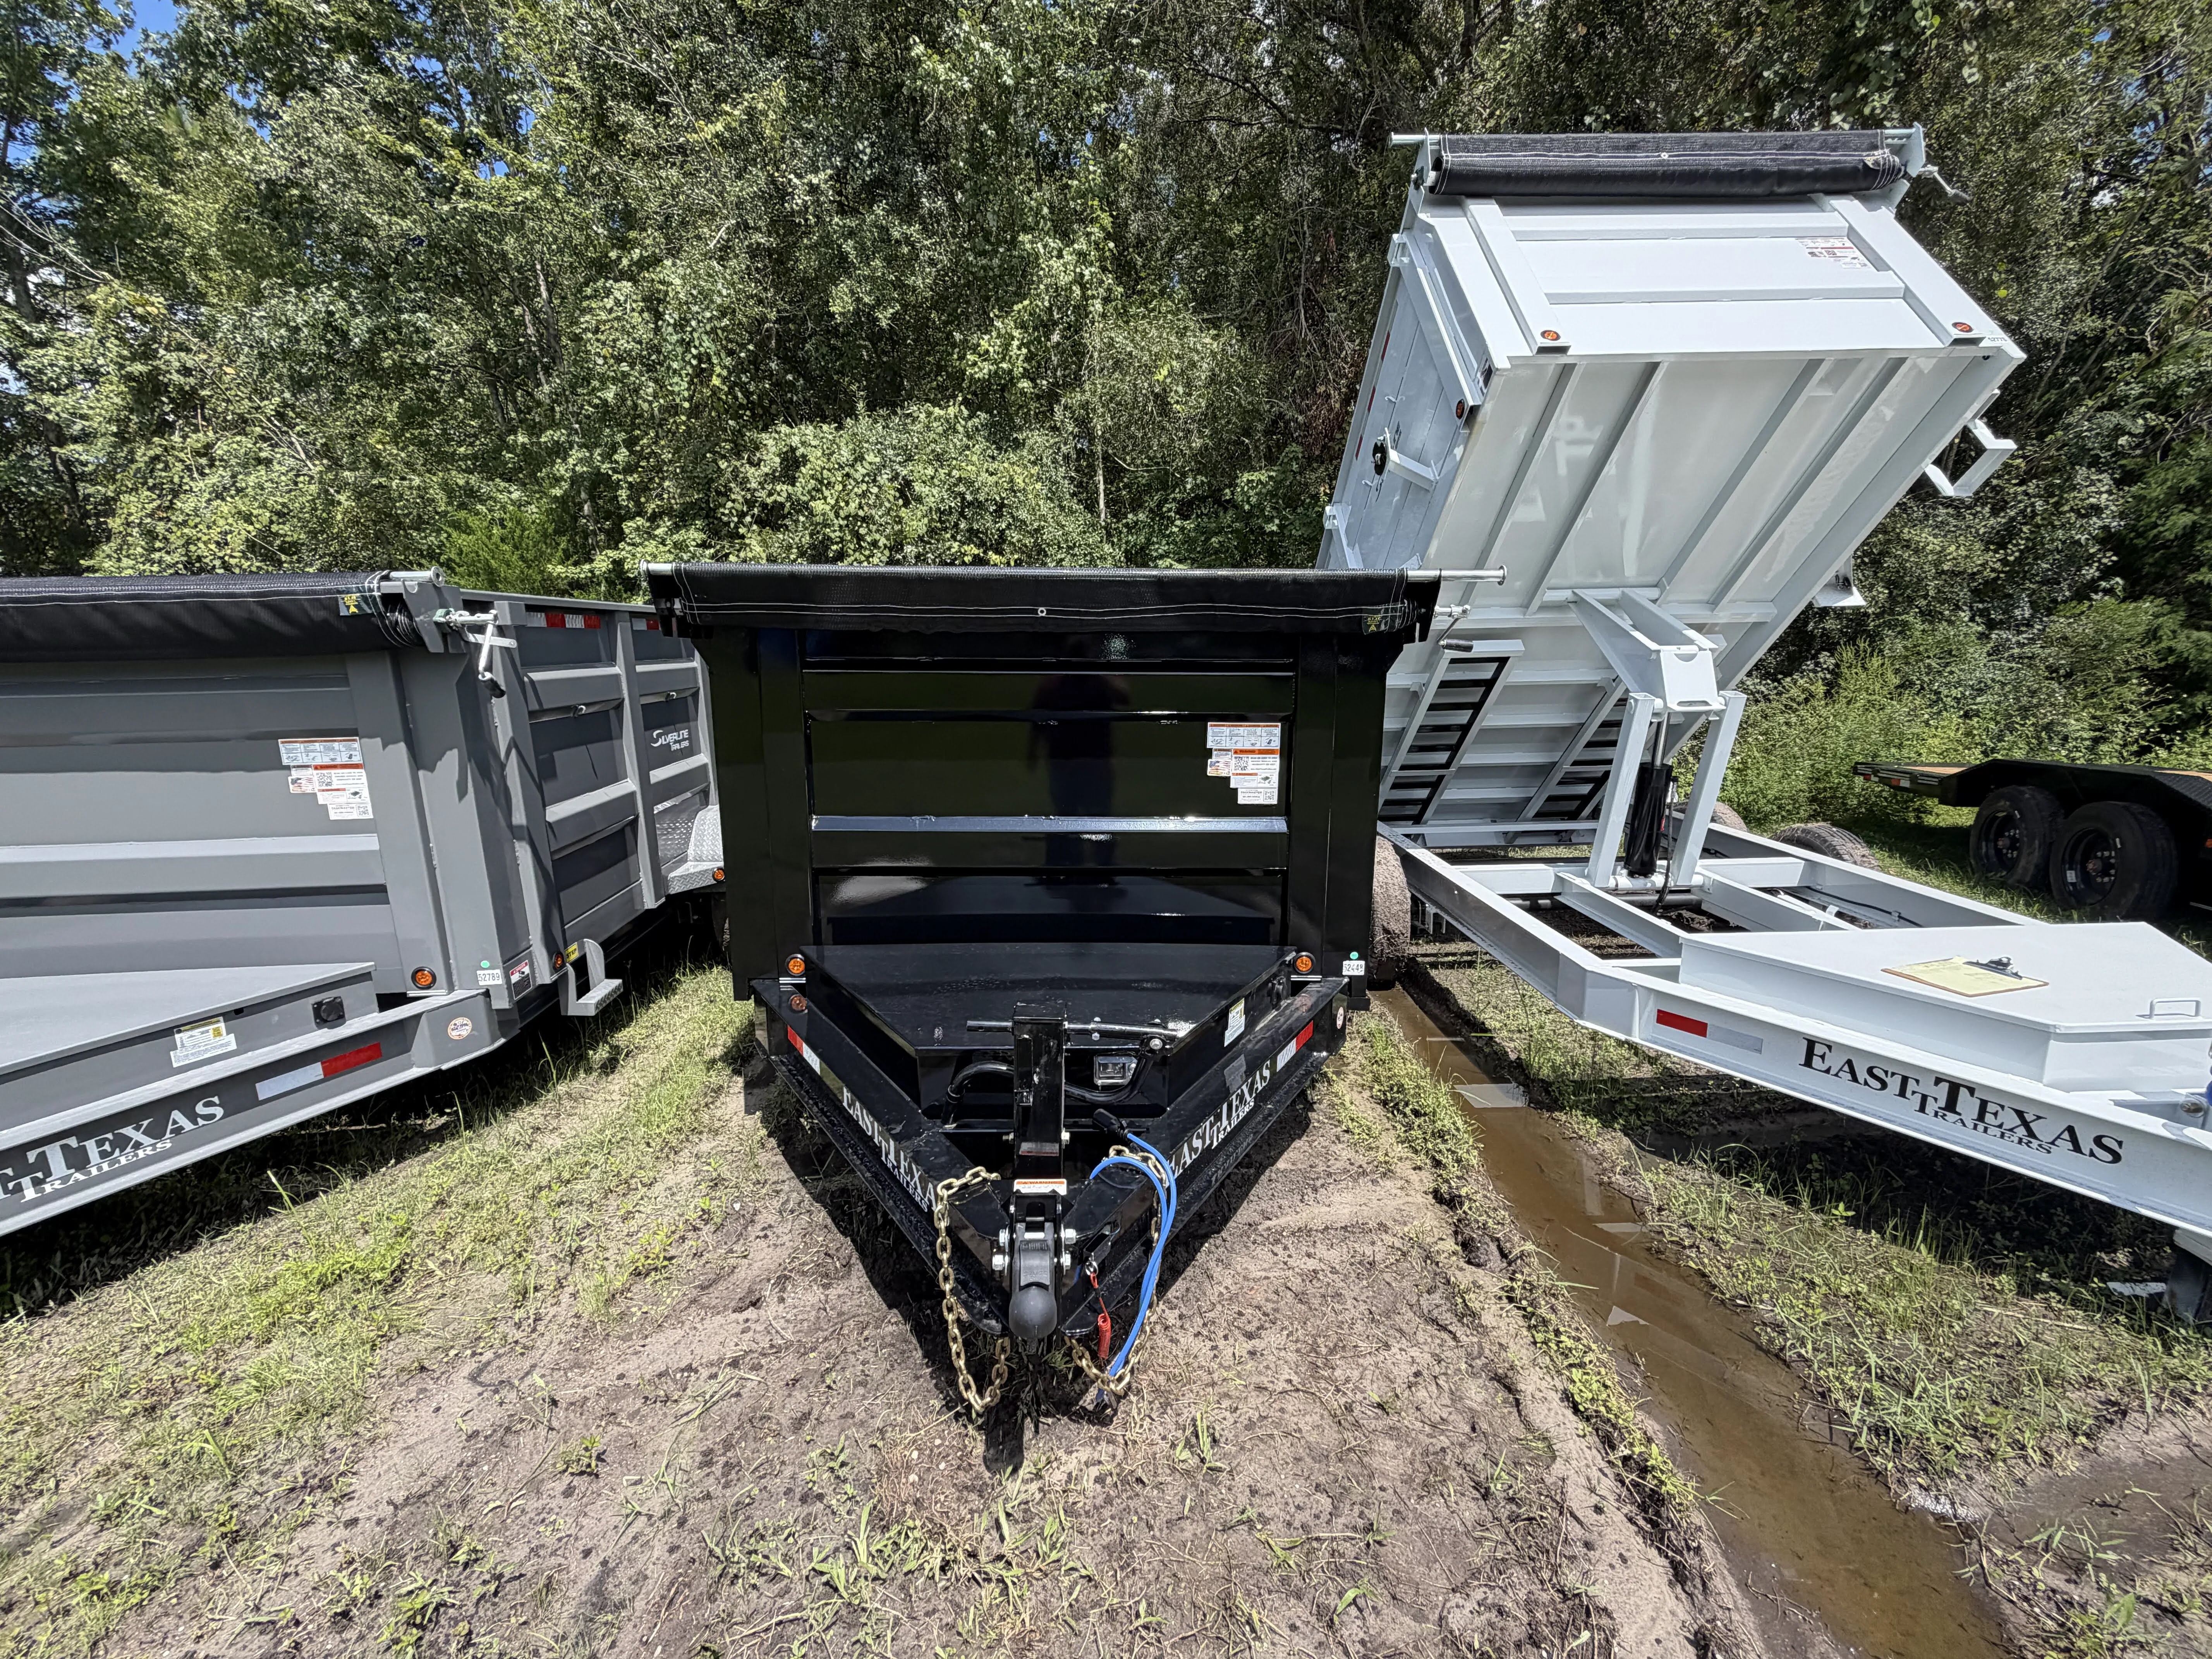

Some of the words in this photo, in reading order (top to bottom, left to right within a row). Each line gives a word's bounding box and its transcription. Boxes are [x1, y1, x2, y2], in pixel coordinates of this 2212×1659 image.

[478, 973, 500, 981] 52789
[1211, 1099, 1255, 1149] TRAILERS
[1218, 1060, 1270, 1130] TEXAS
[1799, 1037, 1920, 1100] EAST
[1934, 1076, 2123, 1164] TEXAS
[1911, 1090, 2053, 1154] TRAILERS
[8, 1139, 172, 1202] TRAILERS
[26, 1096, 224, 1182] TEXAS
[879, 1135, 928, 1212] TRAILERS
[888, 1139, 940, 1214] TEXA
